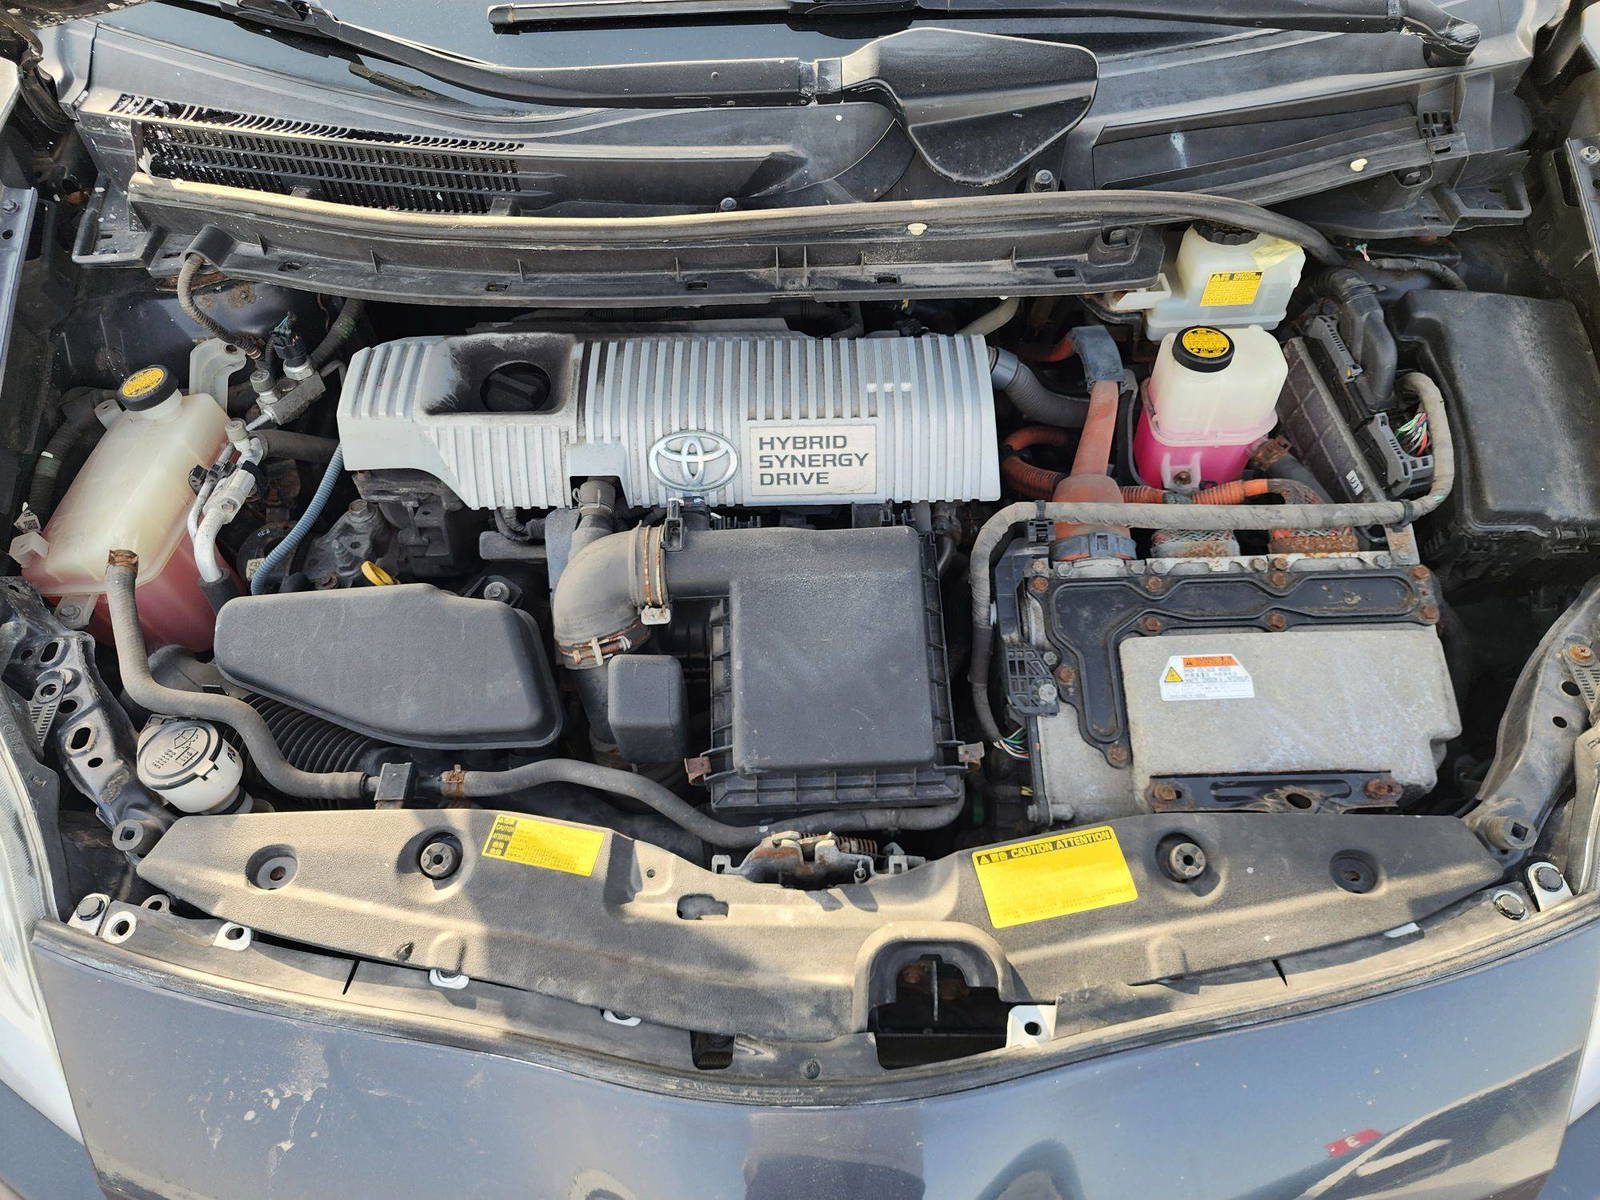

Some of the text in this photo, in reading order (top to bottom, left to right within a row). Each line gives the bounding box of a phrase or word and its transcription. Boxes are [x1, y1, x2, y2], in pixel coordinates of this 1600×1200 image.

[759, 435, 847, 450] HYBRID
[759, 453, 869, 468] SYNERGY
[760, 472, 829, 486] DRIVE
[1011, 842, 1053, 858] CAUTION
[1056, 830, 1110, 849] ATTENTION
